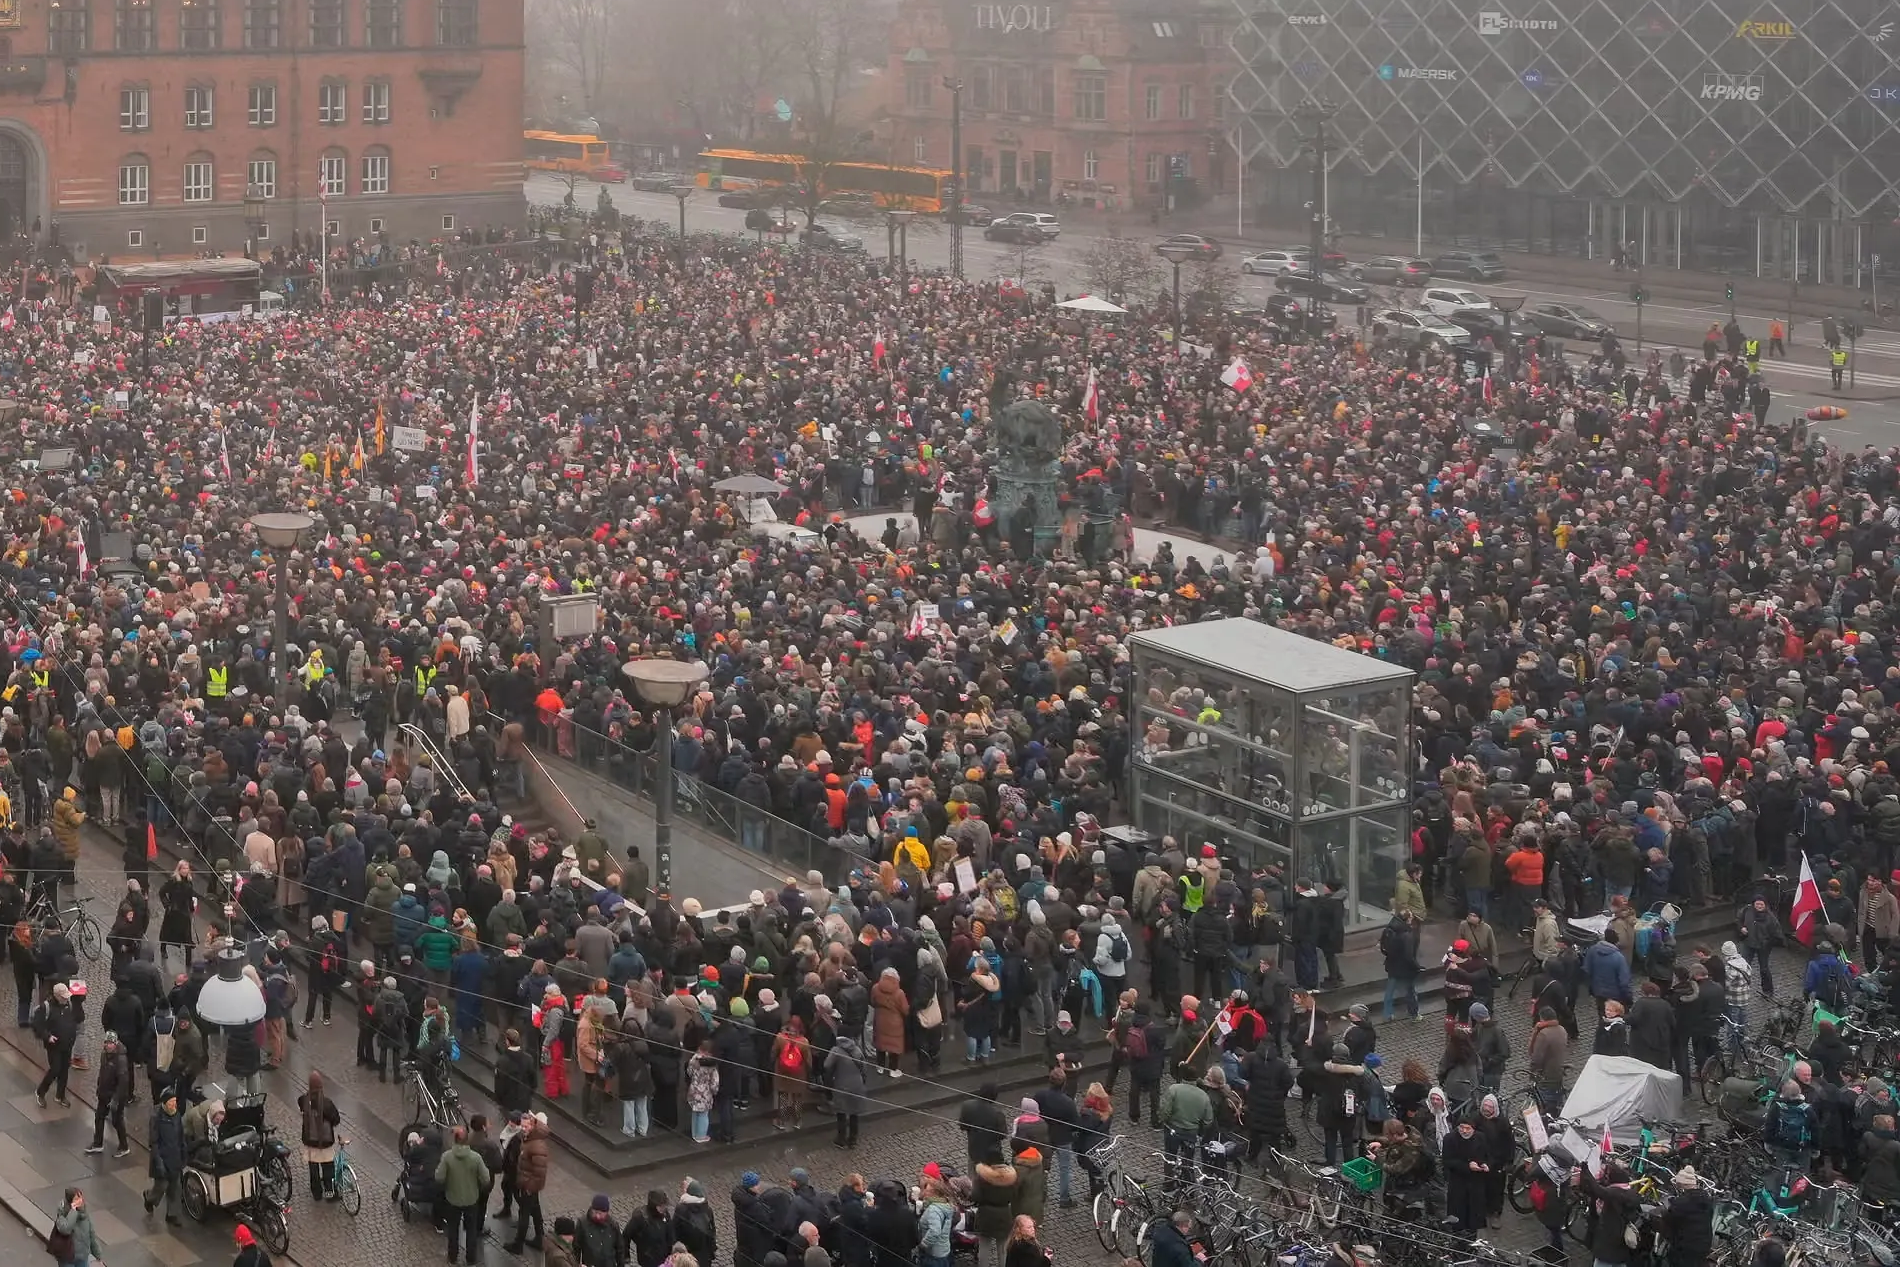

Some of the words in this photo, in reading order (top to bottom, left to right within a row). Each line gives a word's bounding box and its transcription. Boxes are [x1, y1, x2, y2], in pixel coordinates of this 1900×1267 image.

[970, 3, 1053, 33] TIVOLI
[1397, 67, 1457, 81] MAERSK
[1700, 84, 1762, 101] KPMG
